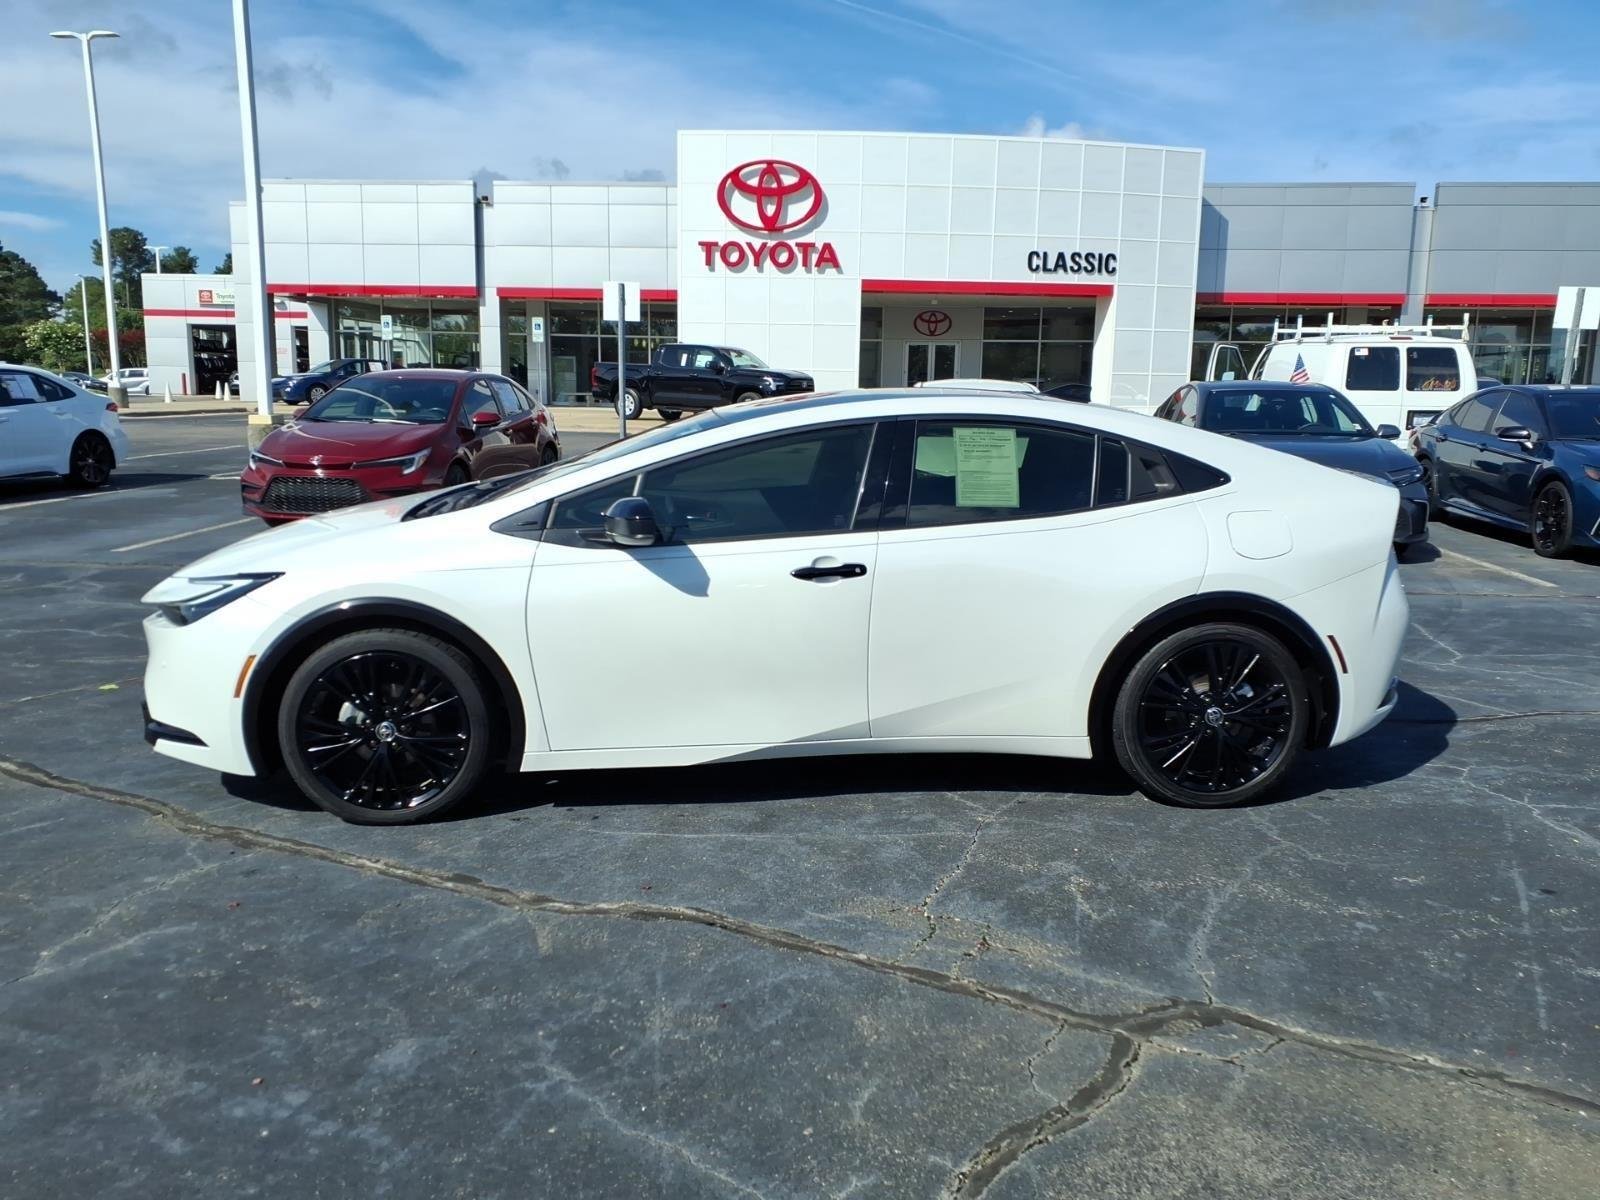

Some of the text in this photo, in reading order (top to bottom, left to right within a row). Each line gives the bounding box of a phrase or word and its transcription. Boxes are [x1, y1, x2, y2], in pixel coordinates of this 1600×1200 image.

[698, 241, 840, 270] TOYOTA
[1027, 250, 1117, 275] CLASSIC
[215, 292, 236, 301] Toyota
